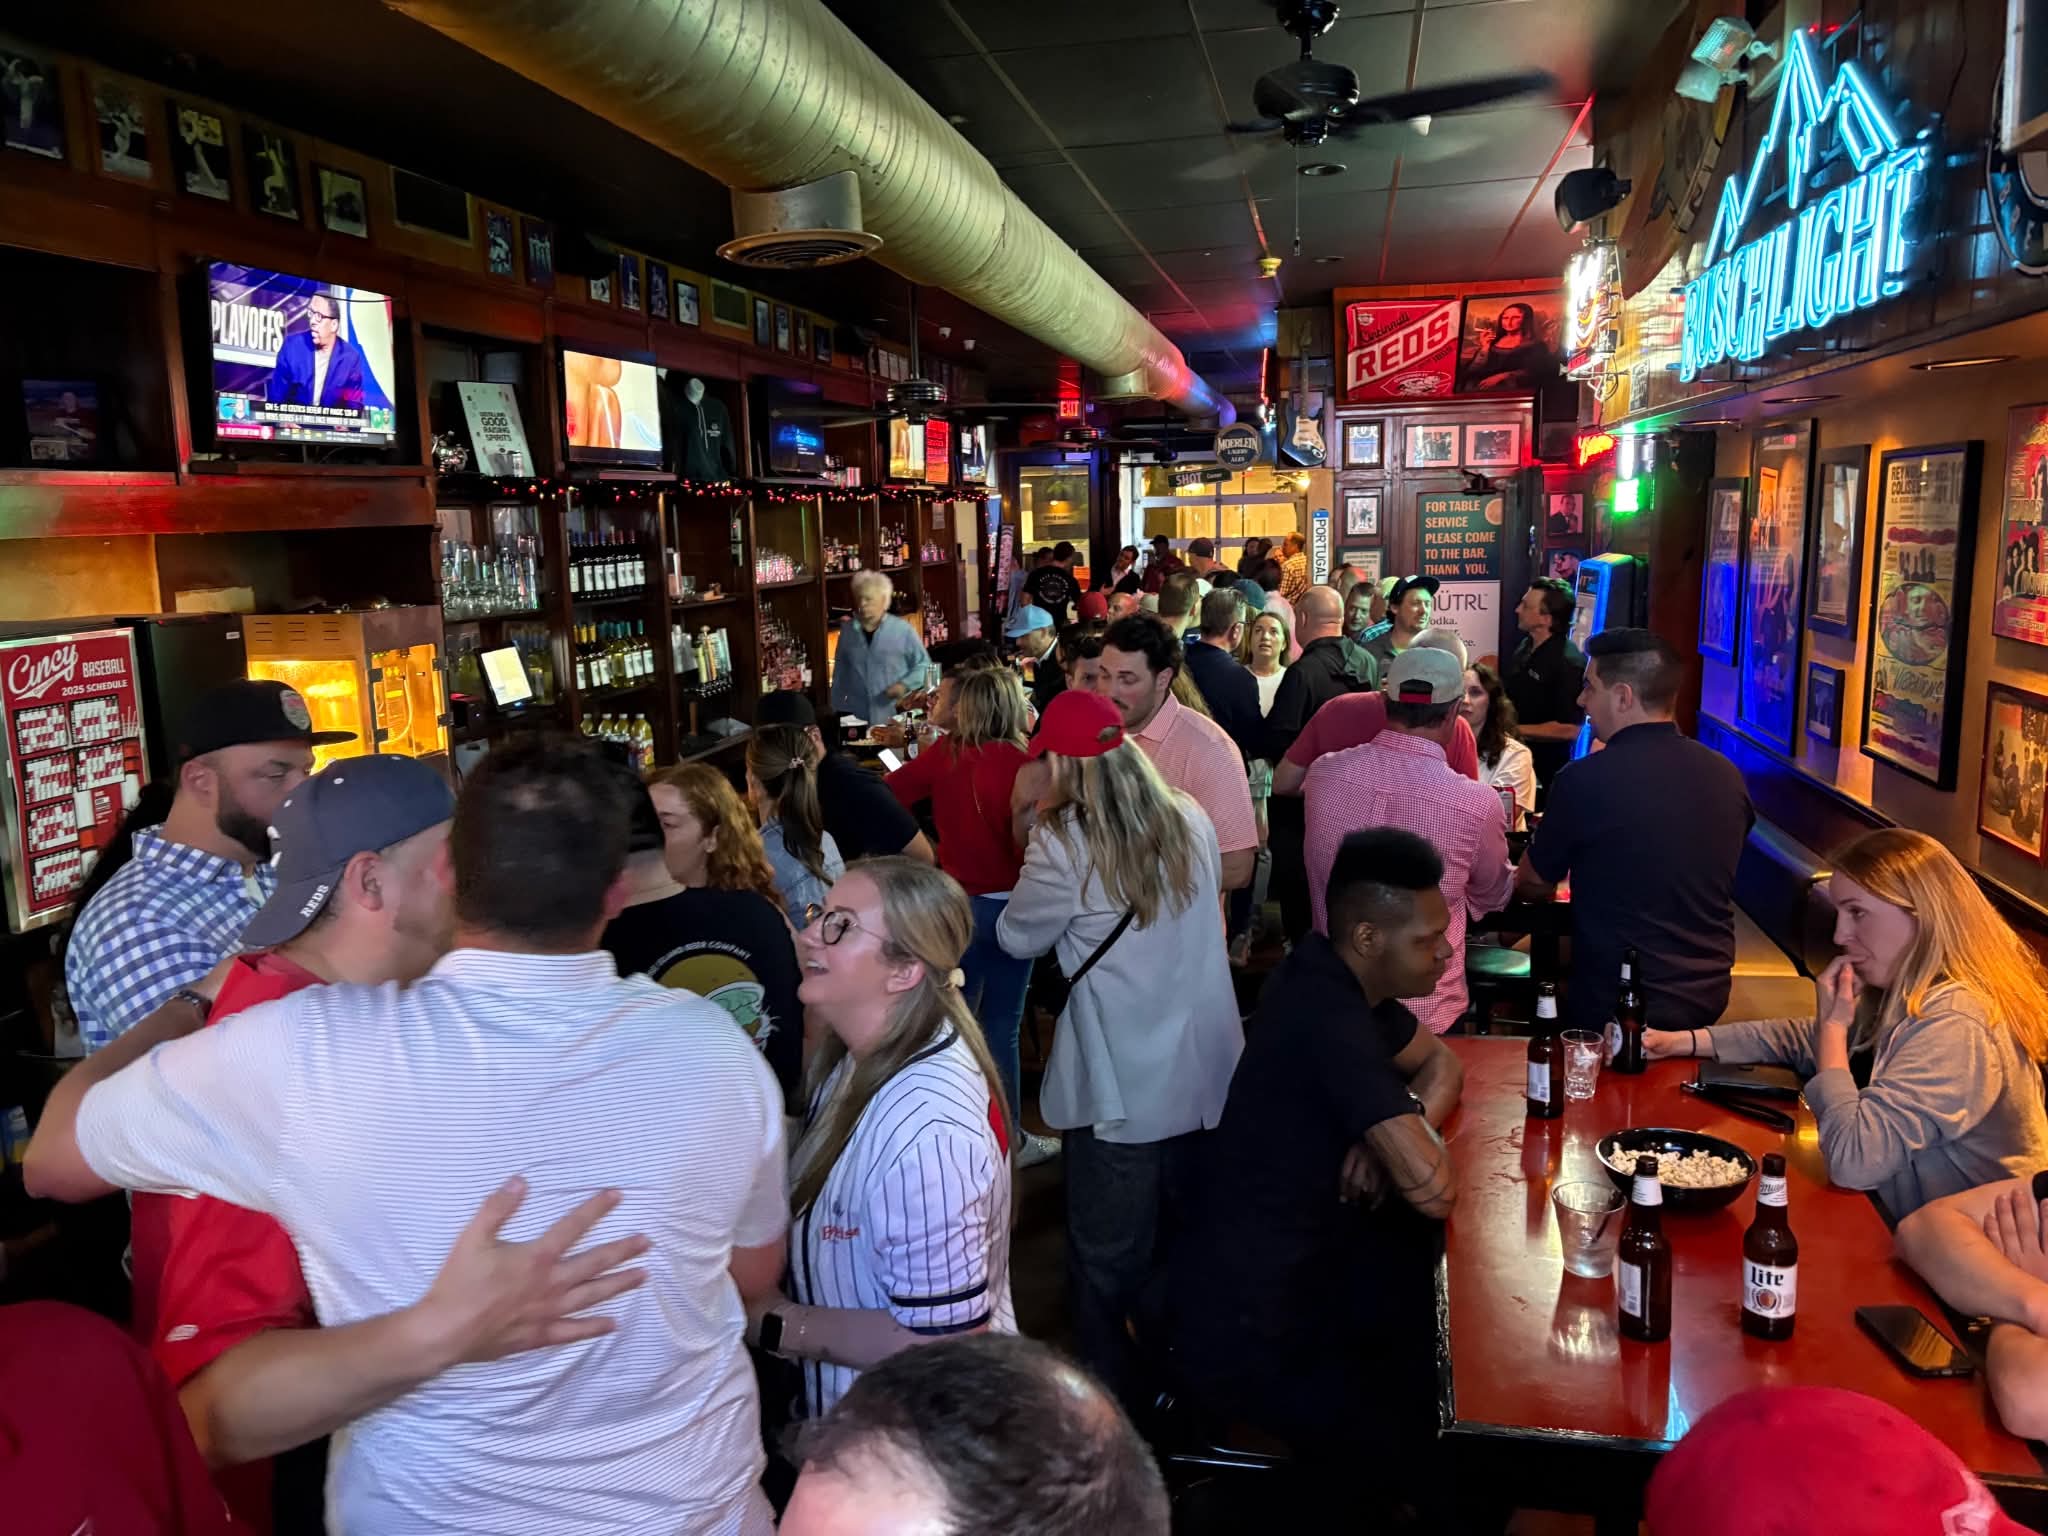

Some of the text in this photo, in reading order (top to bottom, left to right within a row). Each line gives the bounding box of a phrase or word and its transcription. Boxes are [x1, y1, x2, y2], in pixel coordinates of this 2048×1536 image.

[1680, 232, 1776, 383] BUSCH
[1765, 147, 1925, 340] LIGHT
[211, 299, 284, 353] PLAYOFFS
[1355, 310, 1450, 382] REDS
[1060, 400, 1079, 416] EXIT
[481, 417, 508, 427] GOOD
[1217, 436, 1258, 452] MOERLEIN
[1176, 473, 1201, 487] SHOT
[1425, 500, 1480, 512] FOR TABLE
[1425, 516, 1468, 528] SERVICE
[1425, 532, 1496, 544] PLEASE COME
[1315, 519, 1327, 582] PORTUGAL
[1425, 547, 1488, 559] TO THE BAR.
[1424, 563, 1489, 575] THANK YOU.
[1429, 616, 1458, 625] odka.
[8, 644, 79, 700] Cincy
[82, 658, 126, 678] BASEBALL
[62, 684, 85, 697] 2025
[86, 679, 129, 692] SCHEDULE
[299, 884, 329, 918] REDS
[708, 940, 752, 959] COMPANY
[1751, 1266, 1784, 1288] Lite
